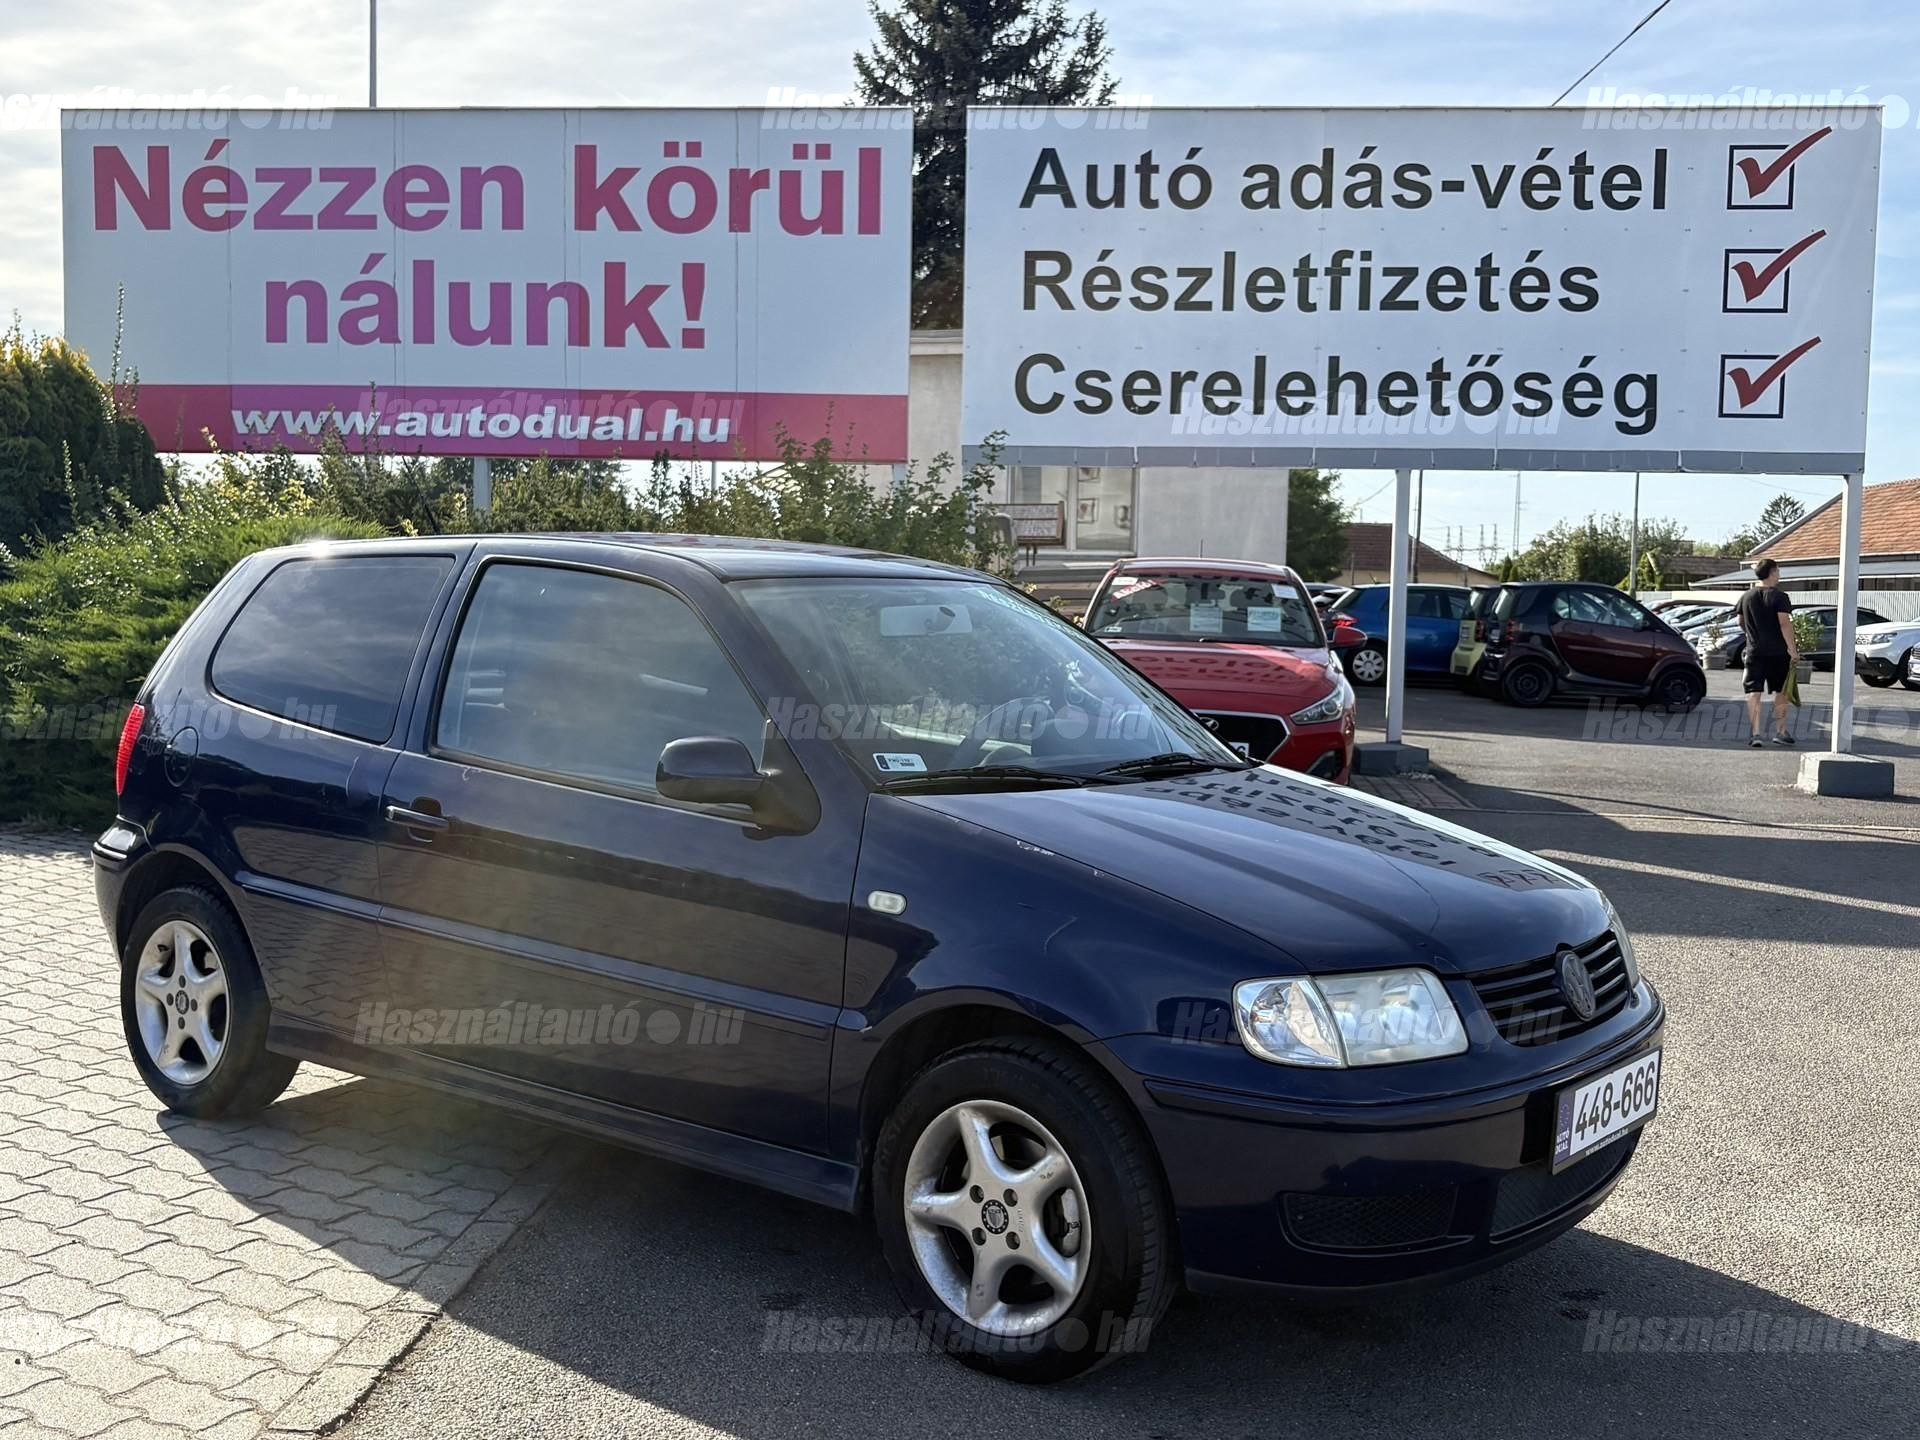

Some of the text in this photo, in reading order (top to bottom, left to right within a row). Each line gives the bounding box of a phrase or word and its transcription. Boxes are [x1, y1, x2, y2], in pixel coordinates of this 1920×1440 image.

[93, 138, 882, 236] Nézzen körül
[1018, 145, 1668, 210] Autó adás-vétel
[265, 252, 706, 349] nálunk!
[1022, 249, 1600, 313] Részletfizetés
[232, 405, 731, 444] www.autodual.hu
[1014, 353, 1659, 435] Cserelehetőség
[1575, 1061, 1655, 1141] 448-666
